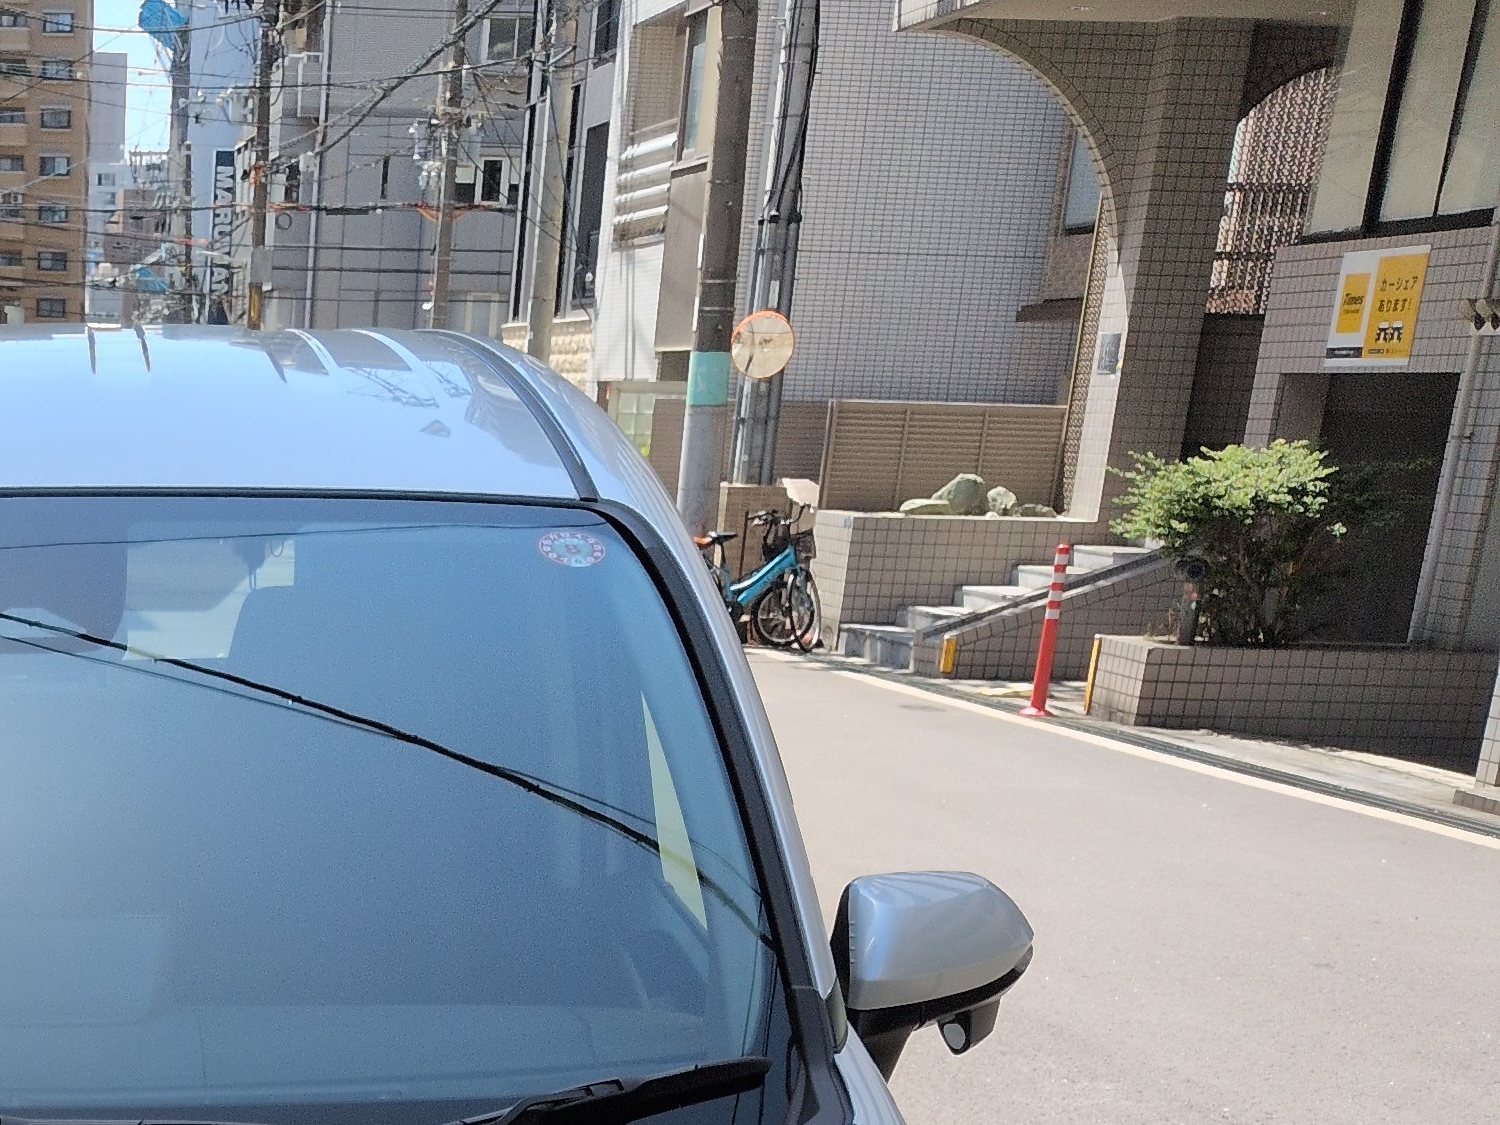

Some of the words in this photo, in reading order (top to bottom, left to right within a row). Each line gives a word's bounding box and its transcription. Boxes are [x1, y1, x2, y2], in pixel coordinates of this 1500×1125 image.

[1380, 276, 1418, 291] カーシェア
